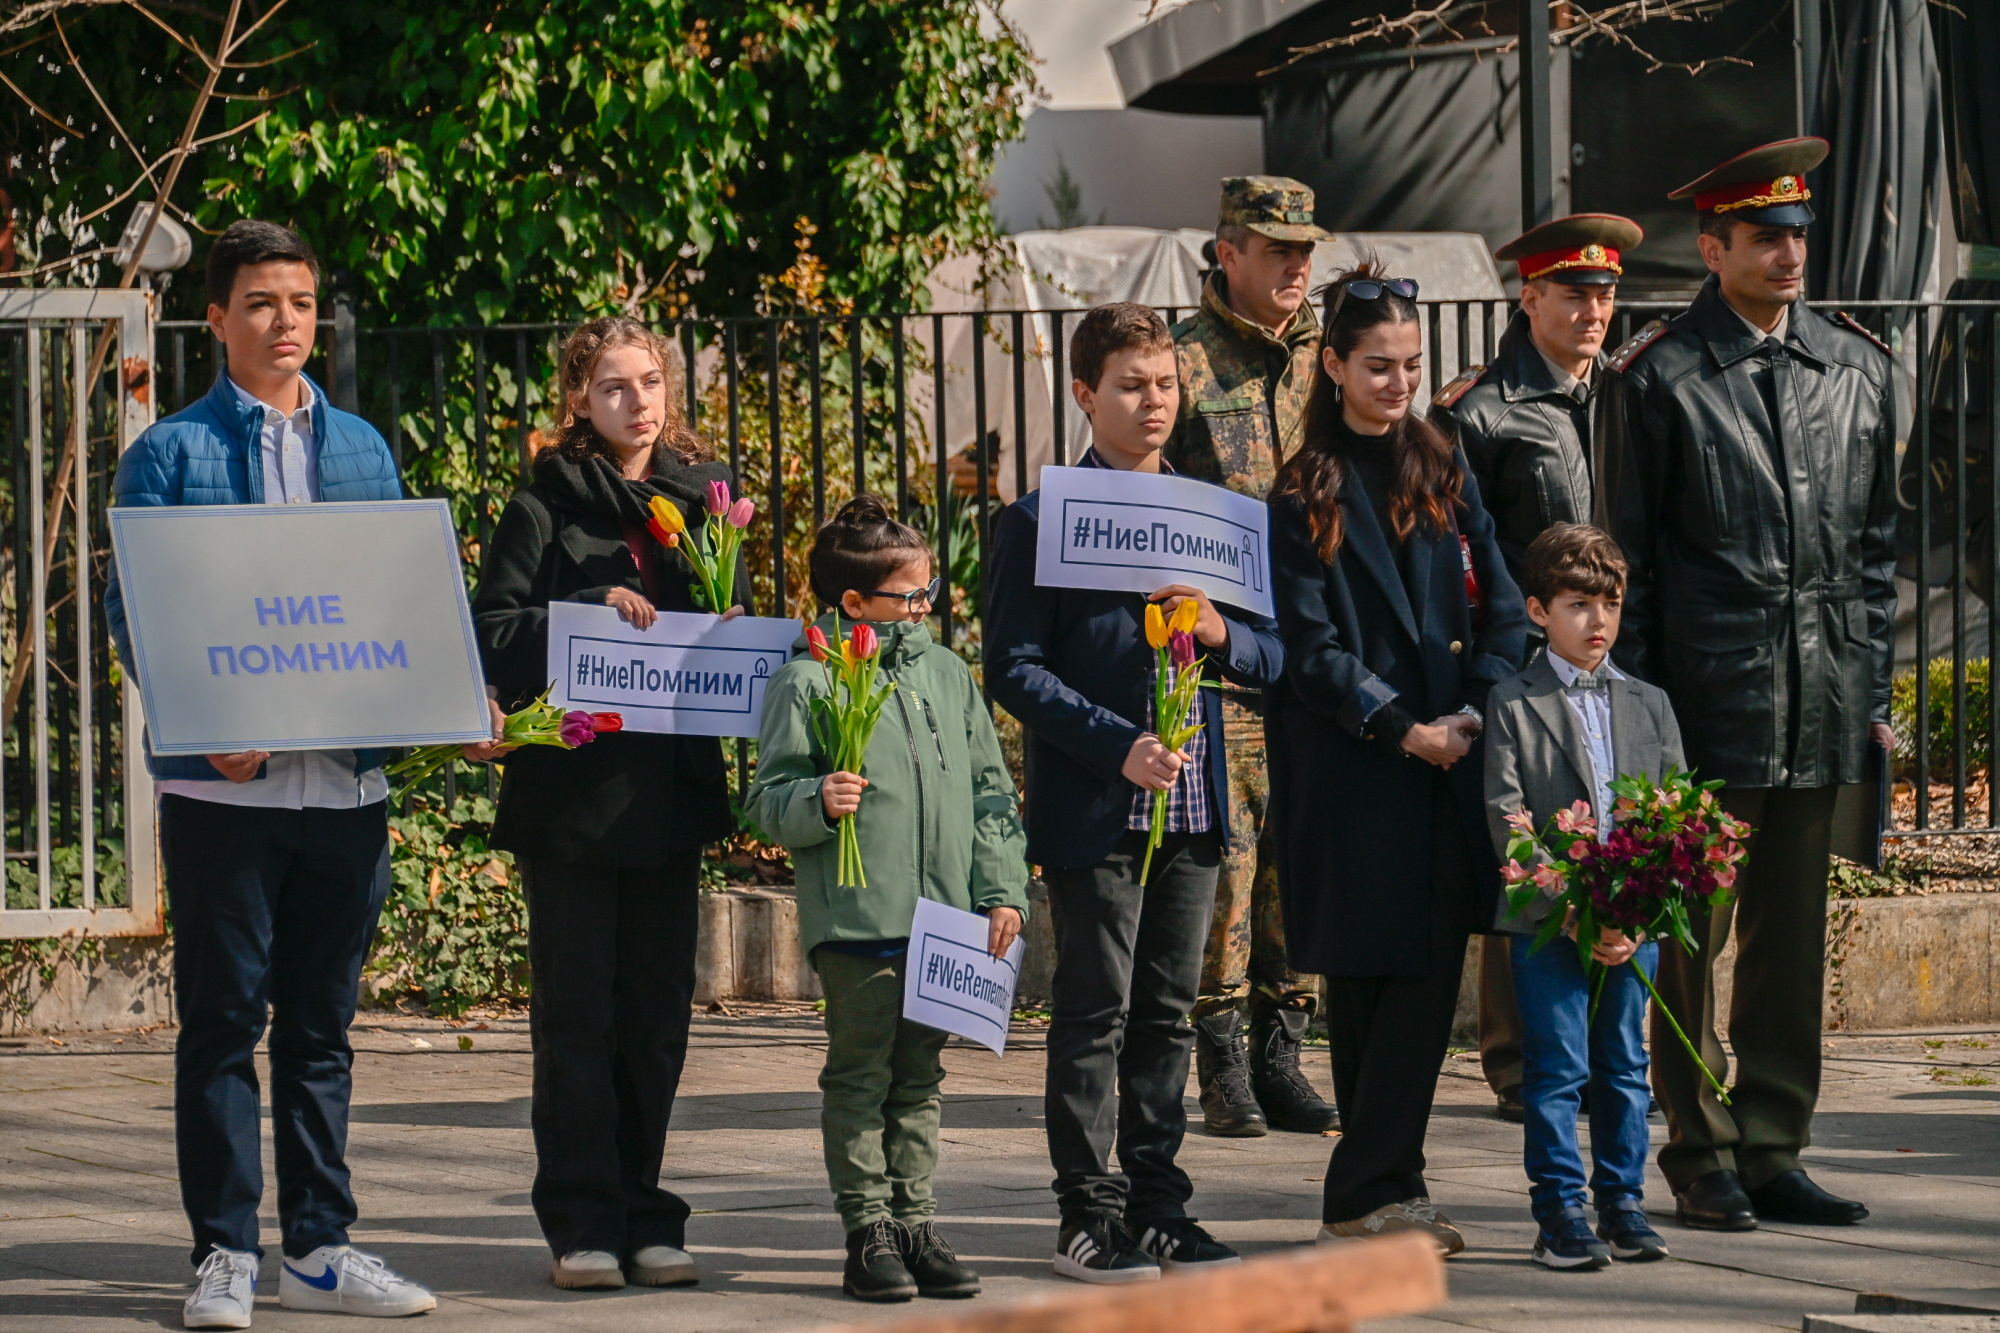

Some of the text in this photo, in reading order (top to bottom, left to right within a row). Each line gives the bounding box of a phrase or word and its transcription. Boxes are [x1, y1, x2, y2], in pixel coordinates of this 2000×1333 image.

[1073, 517, 1239, 569] #НиеПомним
[257, 595, 345, 626] НИЕ
[208, 640, 409, 676] ПОМНИМ
[577, 654, 743, 696] #НиеПомним
